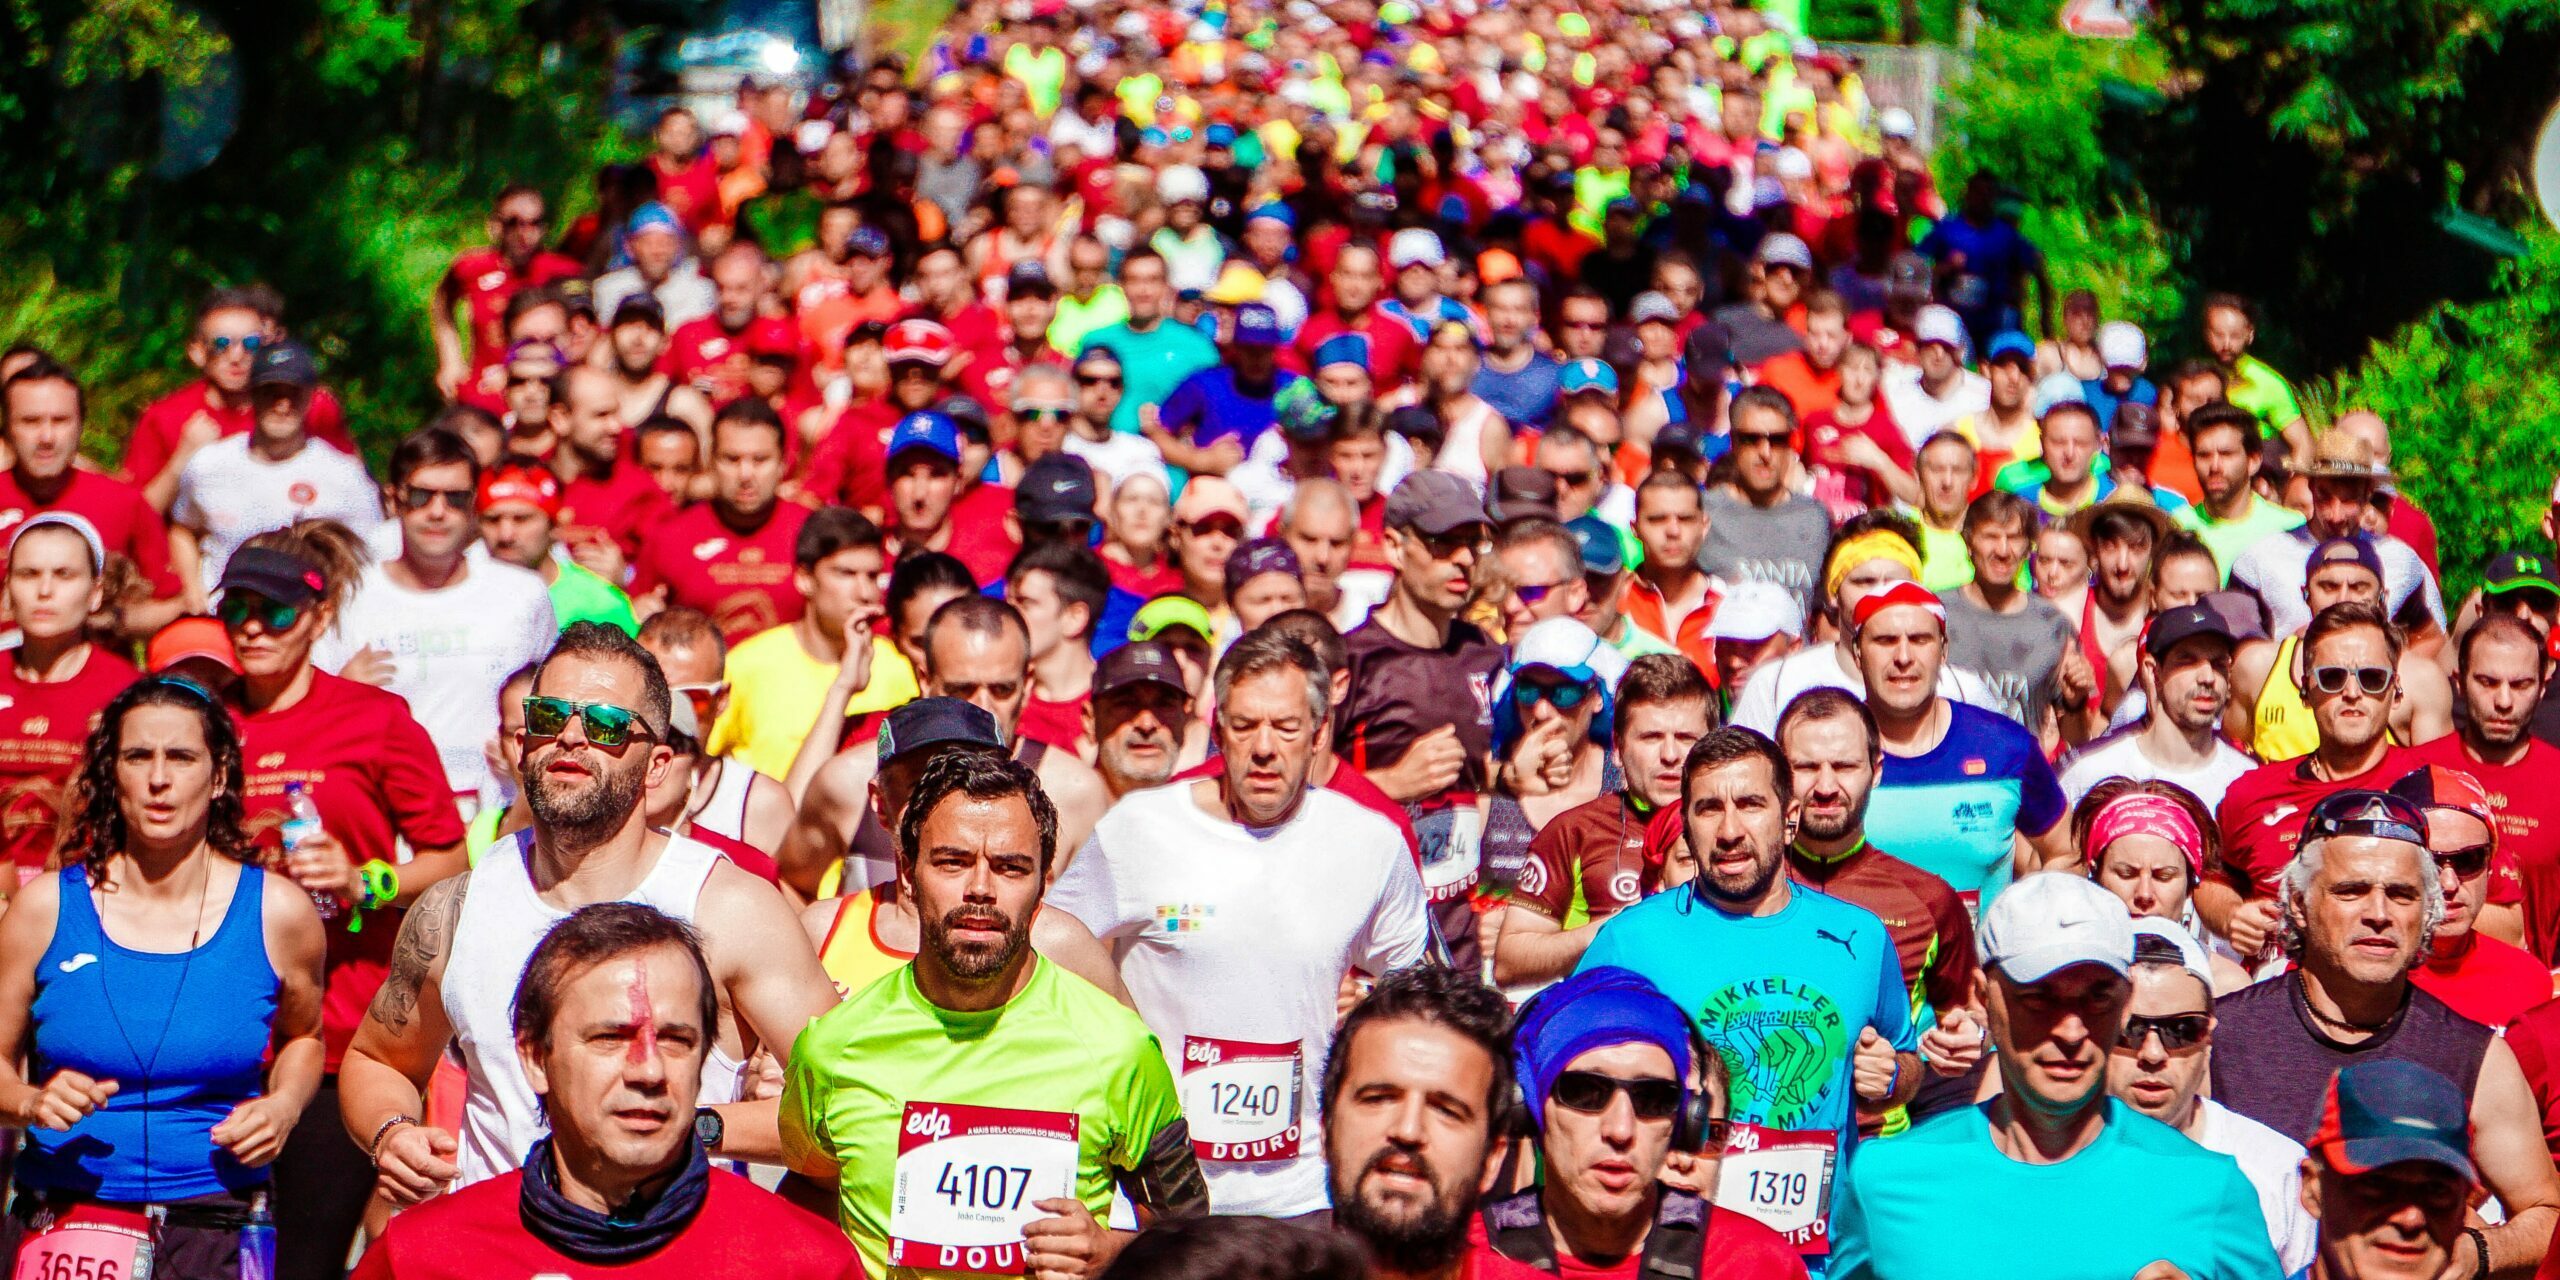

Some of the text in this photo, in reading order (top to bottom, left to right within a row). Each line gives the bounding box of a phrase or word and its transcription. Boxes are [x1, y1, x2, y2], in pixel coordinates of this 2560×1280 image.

[1700, 978, 1840, 1030] MIKKELLER
[1186, 1041, 1221, 1067] edp
[1211, 1082, 1280, 1116] 1240
[1777, 1083, 1831, 1130] MILE
[906, 1107, 951, 1142] edp
[1007, 1126, 1037, 1136] CORRIDA
[1047, 1130, 1072, 1141] MUNDO
[1212, 1126, 1300, 1159] DOURO
[936, 1162, 1032, 1211] 4107
[1749, 1170, 1807, 1206] 1319
[36, 1251, 119, 1280] 3656
